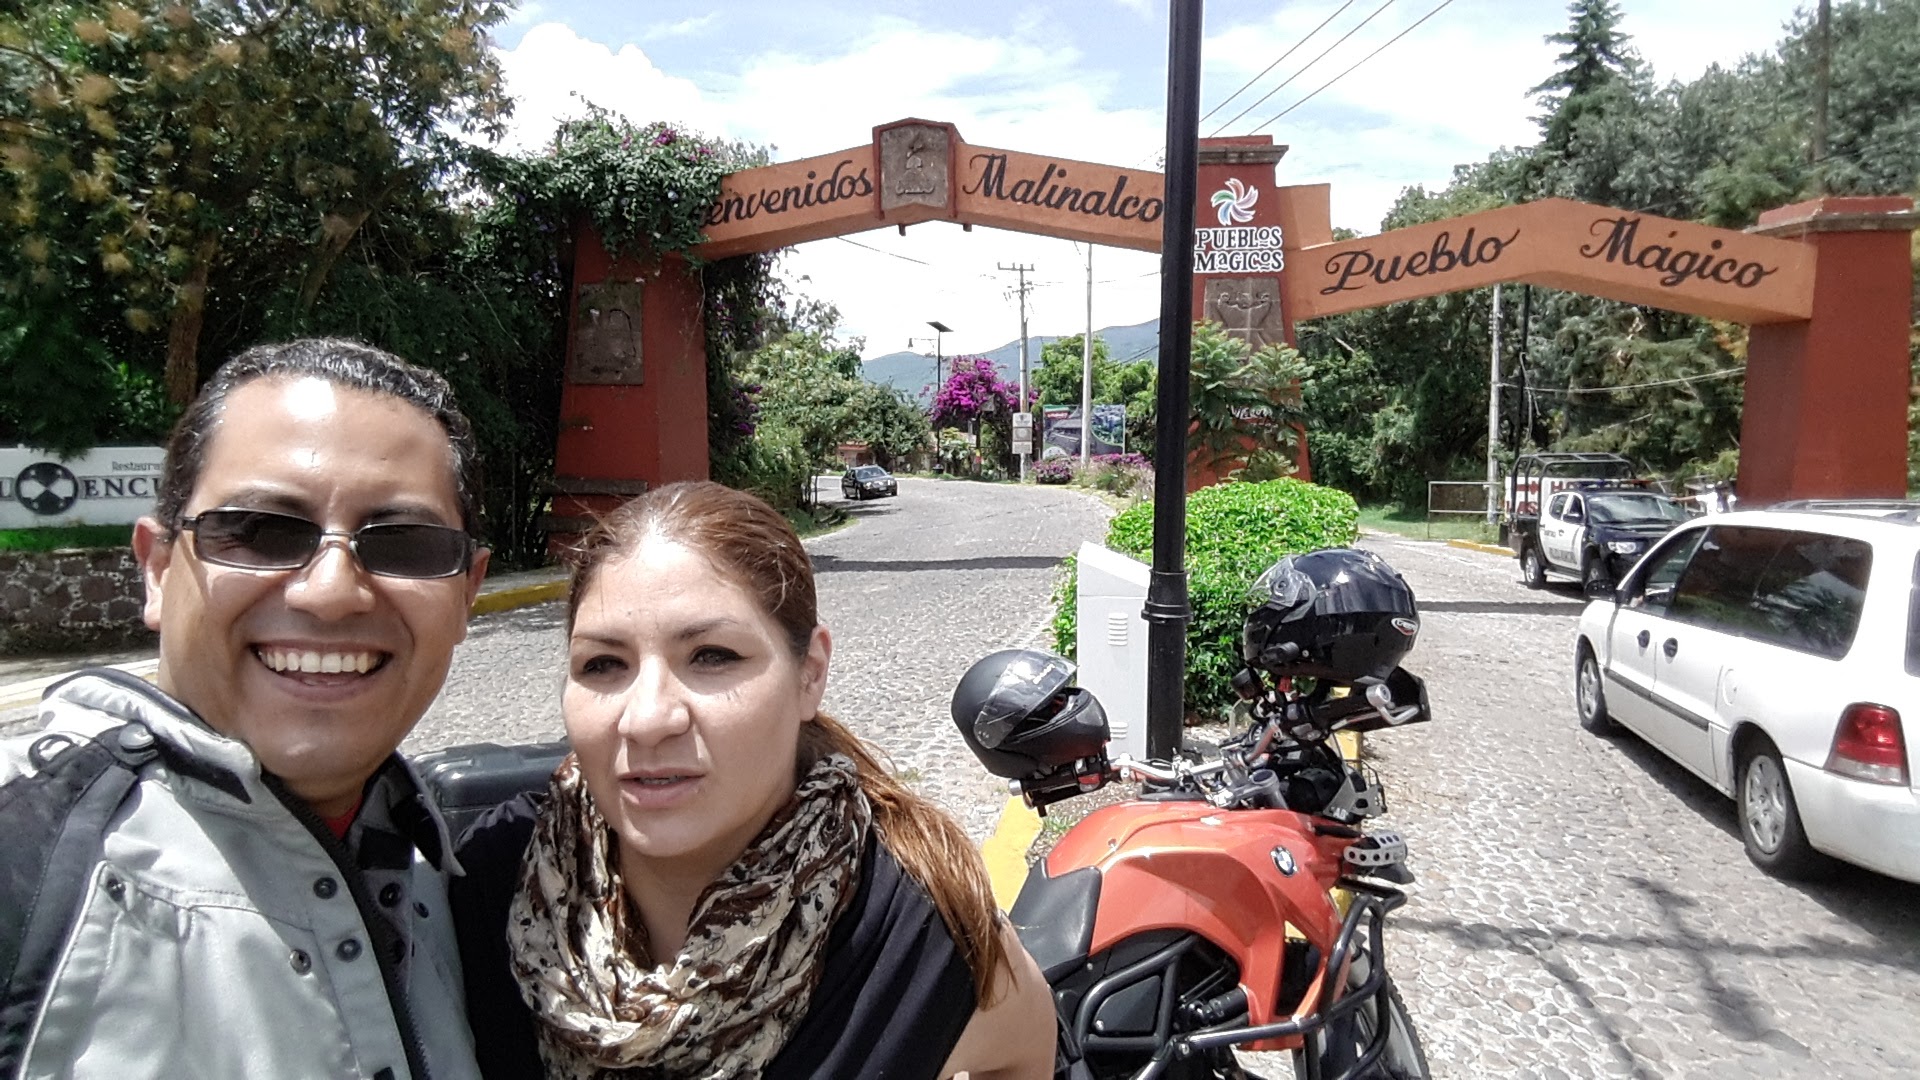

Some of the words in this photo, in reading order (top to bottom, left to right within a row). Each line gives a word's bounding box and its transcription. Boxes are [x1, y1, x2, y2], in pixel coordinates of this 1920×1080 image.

[701, 160, 873, 228] envenidos
[962, 154, 1163, 224] Malinalco
[1320, 227, 1521, 296] Pueblo
[1579, 217, 1778, 288] Mágico
